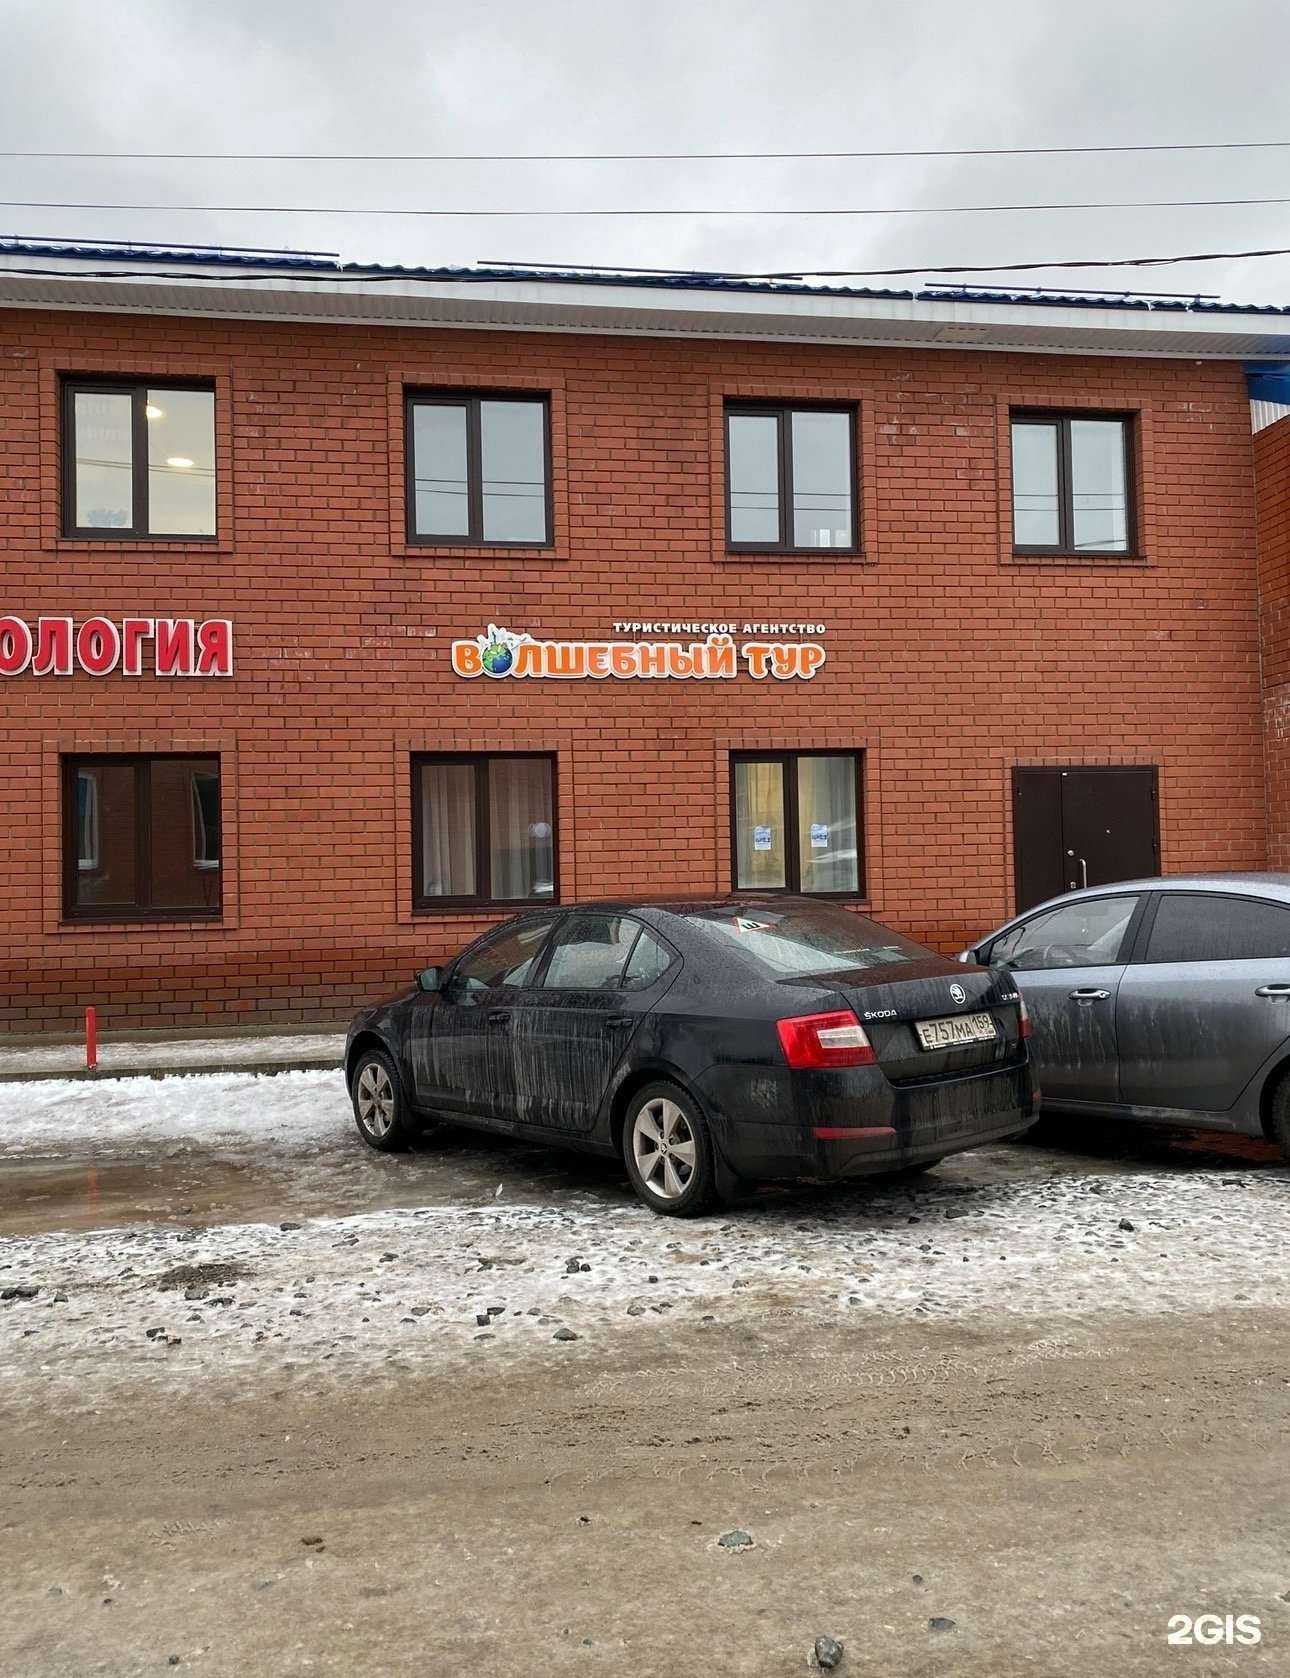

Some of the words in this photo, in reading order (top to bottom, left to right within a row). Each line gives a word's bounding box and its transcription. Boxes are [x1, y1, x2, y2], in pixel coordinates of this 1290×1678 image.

[0, 615, 233, 676] ОЛОГИЯ
[613, 622, 737, 634] ТУРИСТИЧЕСКОЕ
[743, 623, 826, 634] АГЕНТСТВО
[452, 634, 737, 679] ВОЛШЕБНЫЙ
[742, 643, 826, 679] ТУР
